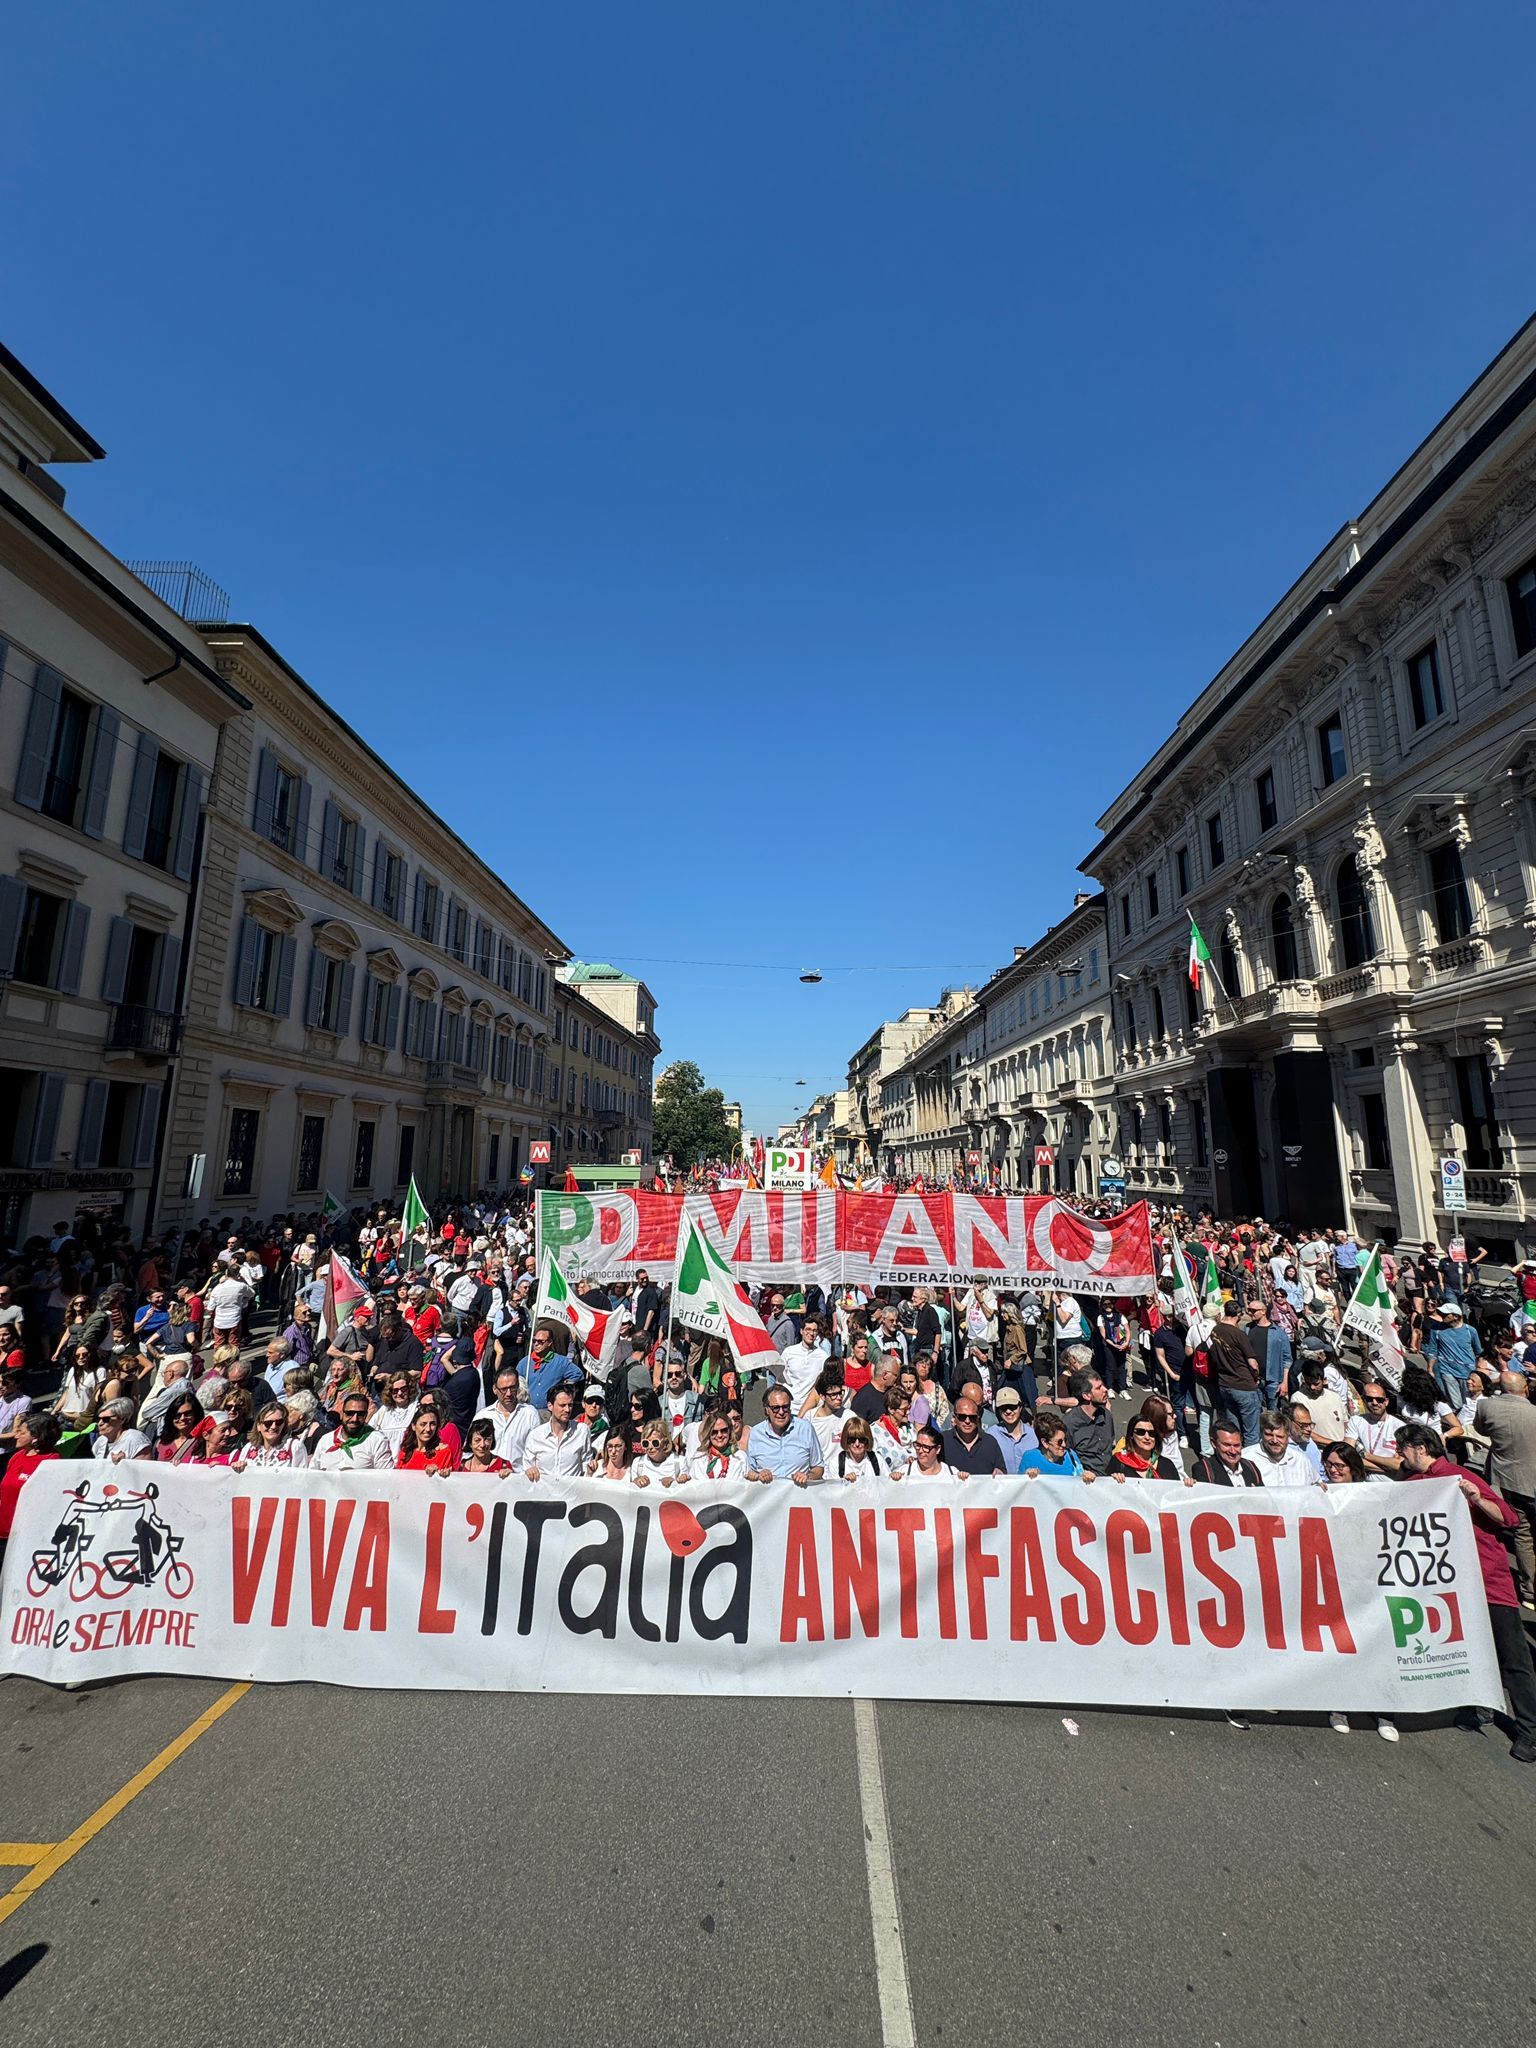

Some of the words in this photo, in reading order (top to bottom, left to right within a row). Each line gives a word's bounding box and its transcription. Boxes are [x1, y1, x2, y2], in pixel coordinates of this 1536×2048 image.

[532, 1146, 549, 1159] M
[771, 1151, 805, 1172] PD
[968, 1153, 980, 1162] M
[1035, 1148, 1053, 1162] M
[581, 1269, 635, 1281] Democratico
[879, 1271, 974, 1285] FEDERAZION
[988, 1276, 1116, 1293] METROPOLITANA
[679, 1307, 713, 1328] artito
[1378, 1513, 1451, 1550] 1945
[231, 1496, 390, 1632] VIVA
[779, 1506, 1357, 1654] ANTIFASCISTA
[1377, 1549, 1456, 1587] 2026
[11, 1606, 55, 1649] ORA
[70, 1608, 199, 1653] SEMPRE
[1385, 1592, 1464, 1648] PD
[1397, 1654, 1423, 1665] Partito
[1426, 1650, 1468, 1663] Democratico
[1400, 1674, 1424, 1682] MILANO
[1425, 1668, 1471, 1680] METROPOLITANA
